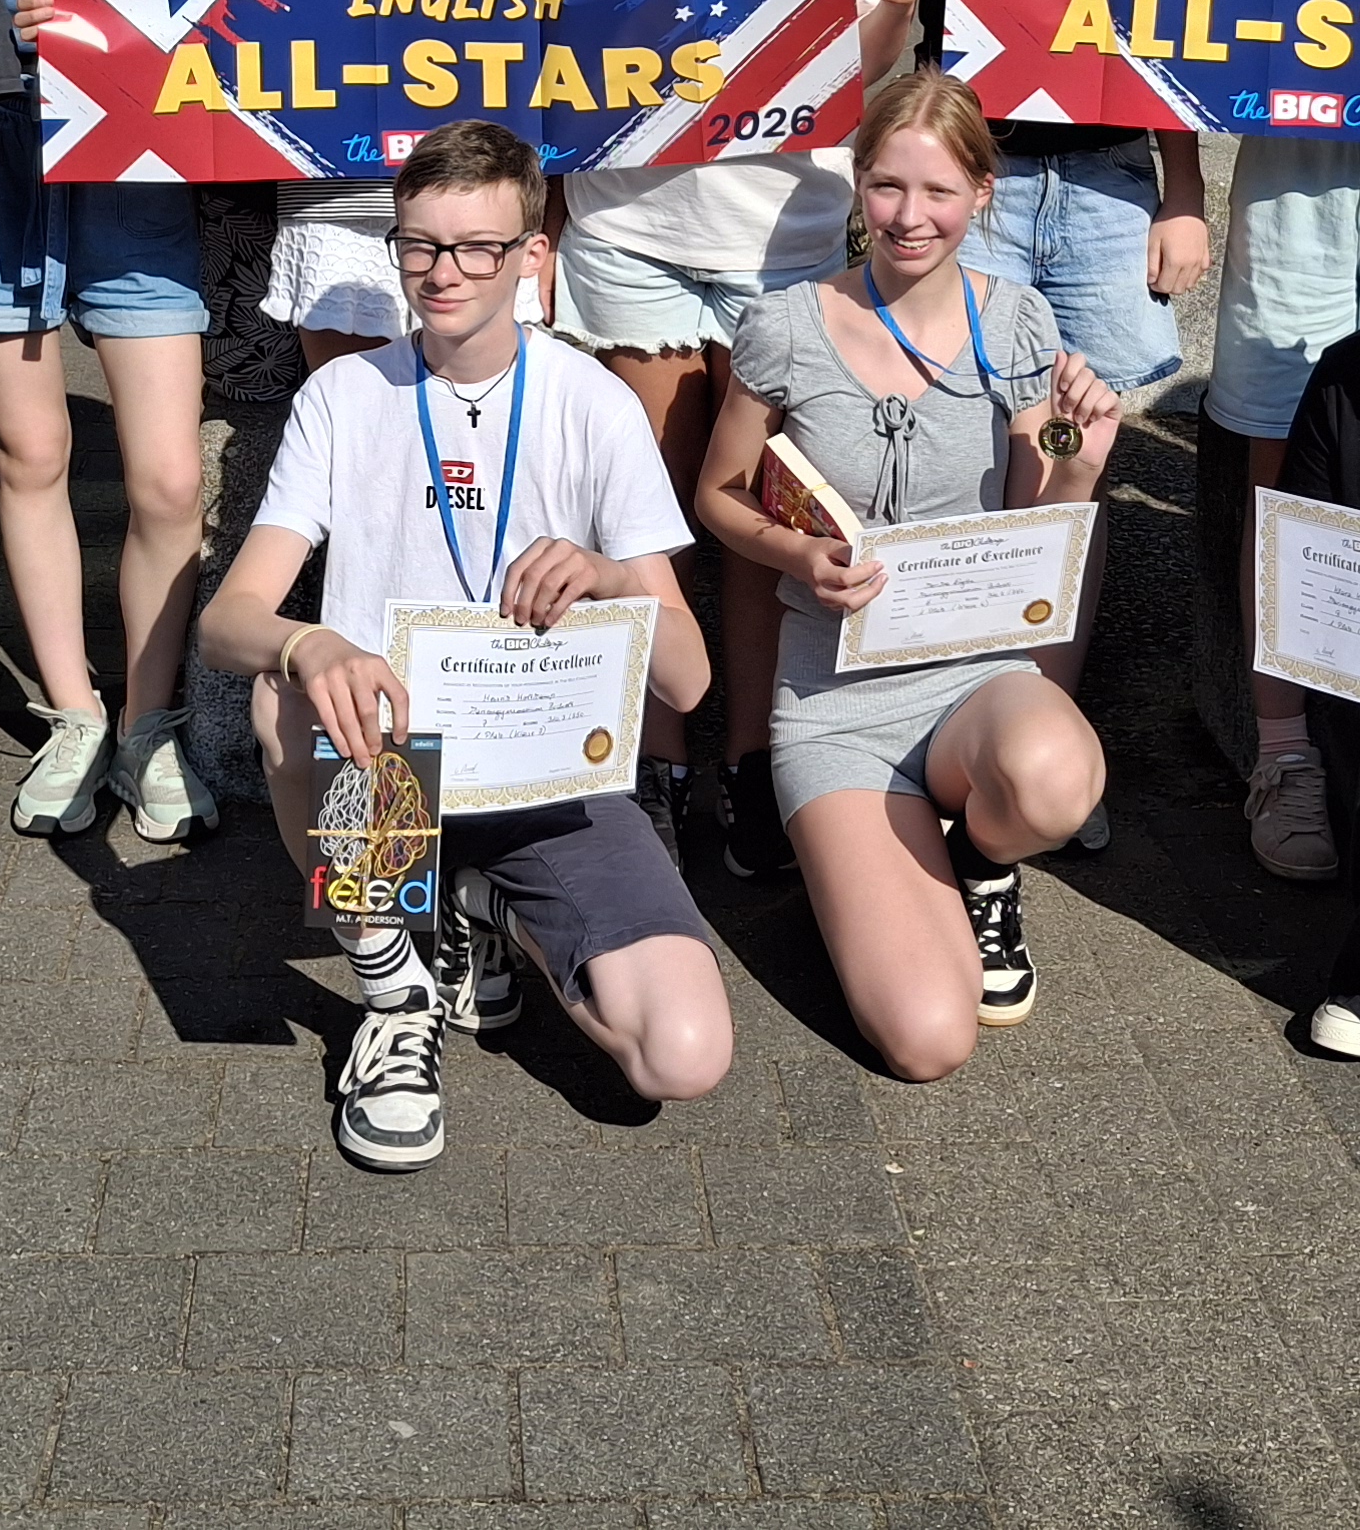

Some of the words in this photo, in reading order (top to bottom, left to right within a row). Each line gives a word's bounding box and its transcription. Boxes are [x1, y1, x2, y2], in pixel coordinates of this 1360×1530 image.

[153, 40, 725, 115] ALL-STARS
[1229, 89, 1272, 119] the
[1273, 93, 1338, 123] BIG
[706, 104, 816, 147] 2026
[342, 133, 385, 162] the
[426, 485, 486, 511] DESEL
[897, 556, 961, 573] Certificate
[965, 553, 978, 565] of
[981, 546, 1044, 563] Excellence
[506, 639, 530, 650] BIG
[441, 656, 516, 674] Certificate
[521, 658, 536, 673] of
[539, 654, 604, 673] Excellence
[310, 866, 433, 914] feed
[355, 916, 405, 926] ADERSON
